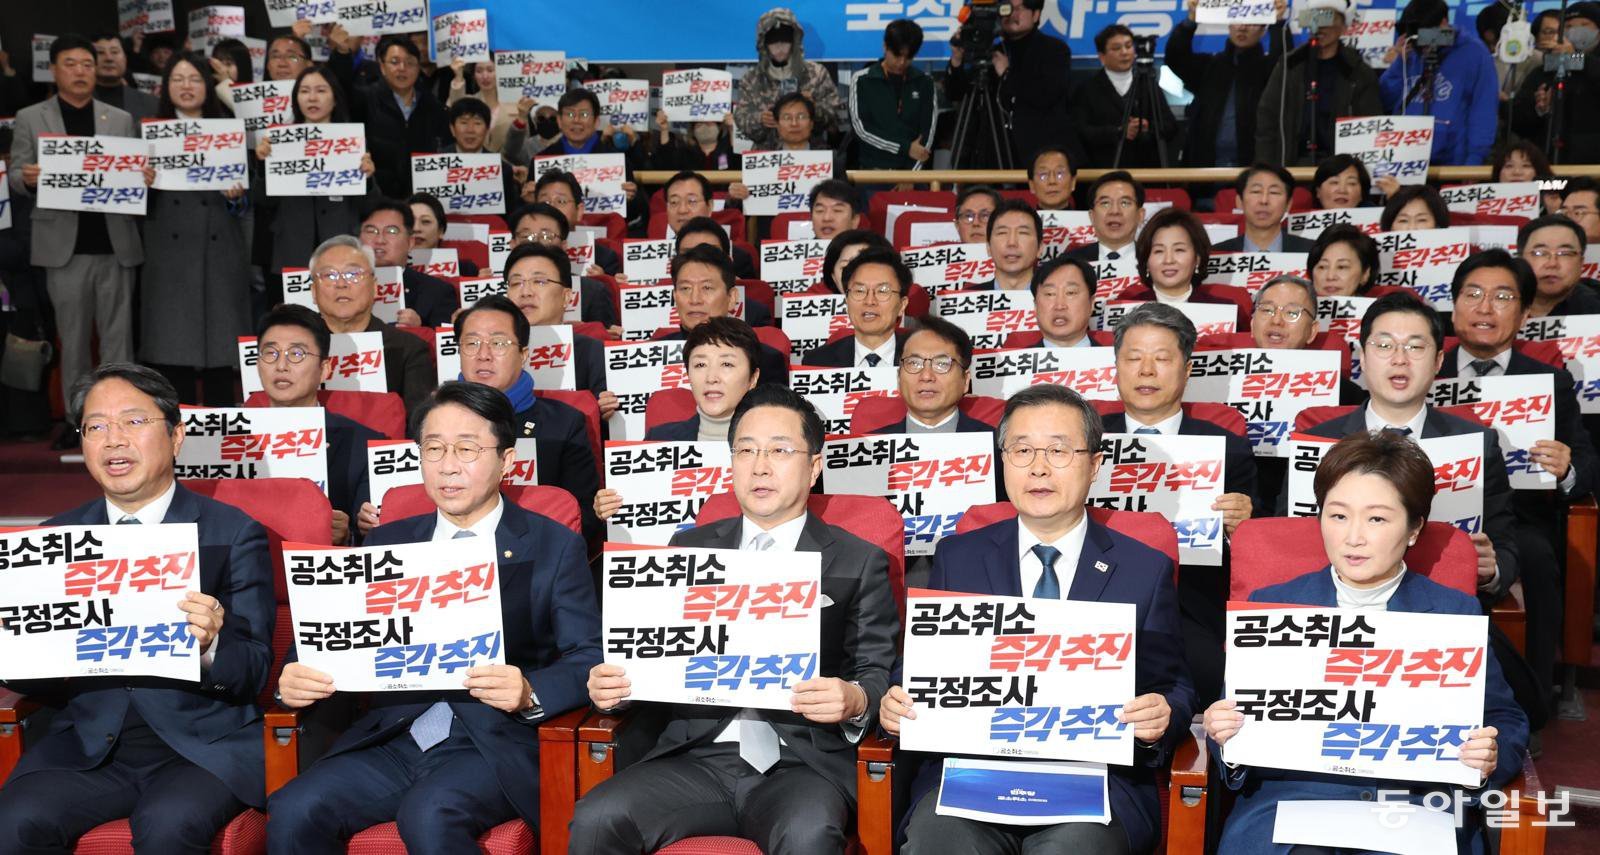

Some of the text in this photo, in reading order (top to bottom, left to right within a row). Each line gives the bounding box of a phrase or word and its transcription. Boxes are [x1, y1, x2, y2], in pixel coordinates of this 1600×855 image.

[338, 1, 388, 20] 국정조사
[146, 121, 202, 140] 공소취소
[244, 114, 283, 130] 정조사
[1339, 120, 1394, 138] 공소취소
[627, 244, 677, 261] 공소취
[904, 247, 966, 268] 공소취소
[1207, 256, 1271, 274] 공소취소
[1392, 250, 1430, 269] 즉각
[1432, 244, 1468, 265] 추진
[945, 262, 976, 280] 즉각
[625, 291, 675, 308] 공소취
[941, 294, 1011, 315] 공소취소
[1318, 301, 1356, 319] 취소
[986, 310, 1022, 331] 즉각
[340, 350, 381, 377] 추진
[530, 343, 571, 369] 추진
[976, 351, 1059, 378] 공소취소
[1191, 353, 1272, 377] 공소취소
[794, 371, 872, 394] 공소취소
[1076, 366, 1116, 392] 추진
[1243, 371, 1337, 398] 즉각 추진
[185, 412, 251, 436] 소취소
[1501, 394, 1552, 425] 추진
[220, 428, 322, 461] 즉각 추진
[1248, 422, 1288, 446] 즉각
[609, 445, 702, 475] 공소취소
[827, 438, 919, 469] 공소취소
[672, 467, 720, 496] 즉각
[888, 454, 991, 490] 즉각 추진
[1110, 459, 1222, 492] 즉각 추진
[64, 552, 196, 596] 즉각 추진
[291, 550, 403, 585] 공소취소
[609, 554, 726, 589] 공소취소
[366, 562, 494, 615] 즉각 추진
[683, 580, 818, 621] 즉각 추진
[0, 598, 113, 635] 국정조사
[911, 603, 1035, 636] 공소취소
[1233, 614, 1376, 648] 공소취소
[76, 621, 195, 662] 즉각 추진
[299, 616, 412, 652] 국정조사
[607, 625, 728, 659] 국정조사
[374, 631, 500, 680] 즉각 추진
[990, 632, 1132, 672] 즉각 추진
[1323, 646, 1483, 688] 즉각 추진
[685, 652, 818, 690] 즉각 추진
[908, 675, 1037, 708] 국정조사
[1234, 689, 1376, 722] 국정조사
[990, 703, 1128, 743] 즉각 추진
[1320, 722, 1479, 761] 즉각 추진
